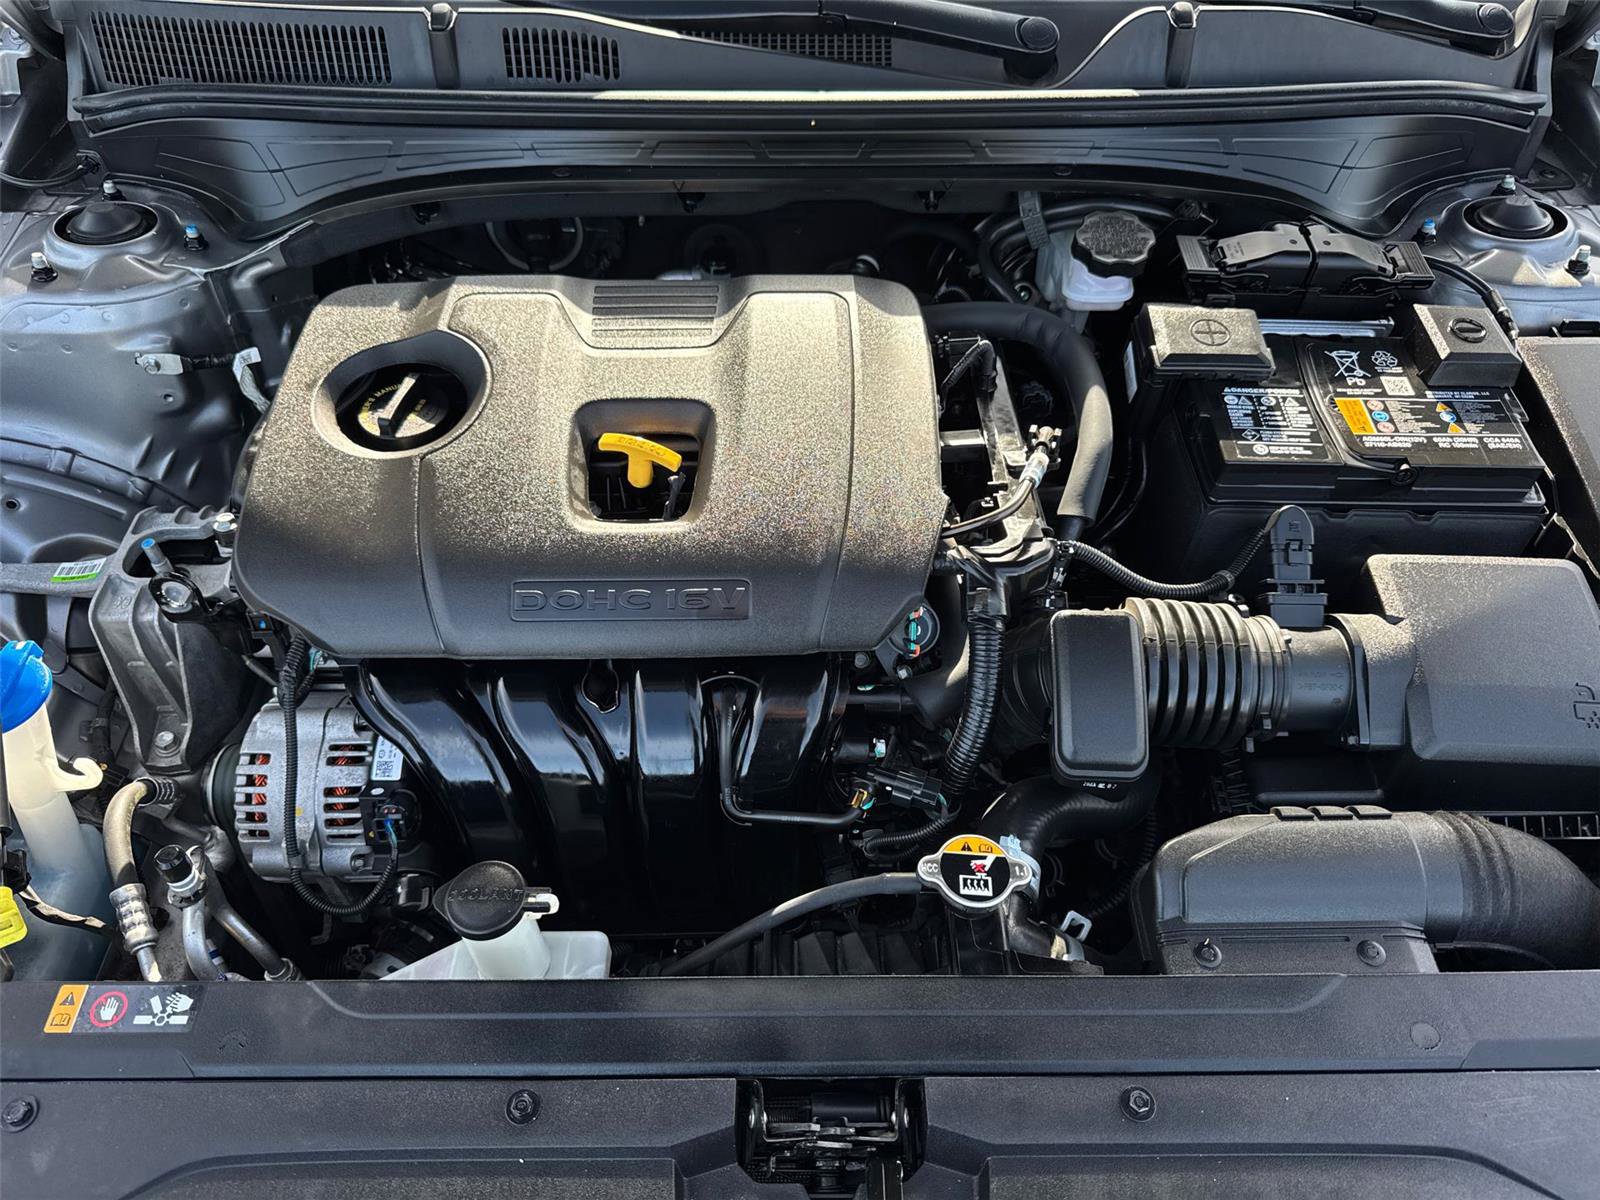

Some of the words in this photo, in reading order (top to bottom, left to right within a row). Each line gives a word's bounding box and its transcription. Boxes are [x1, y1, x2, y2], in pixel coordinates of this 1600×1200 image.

[1346, 377, 1366, 386] Pb
[514, 589, 652, 611] DOHC
[665, 587, 746, 610] 16V
[921, 863, 939, 873] HCC
[1014, 866, 1028, 876] 1.1
[447, 887, 524, 902] COOLANT
